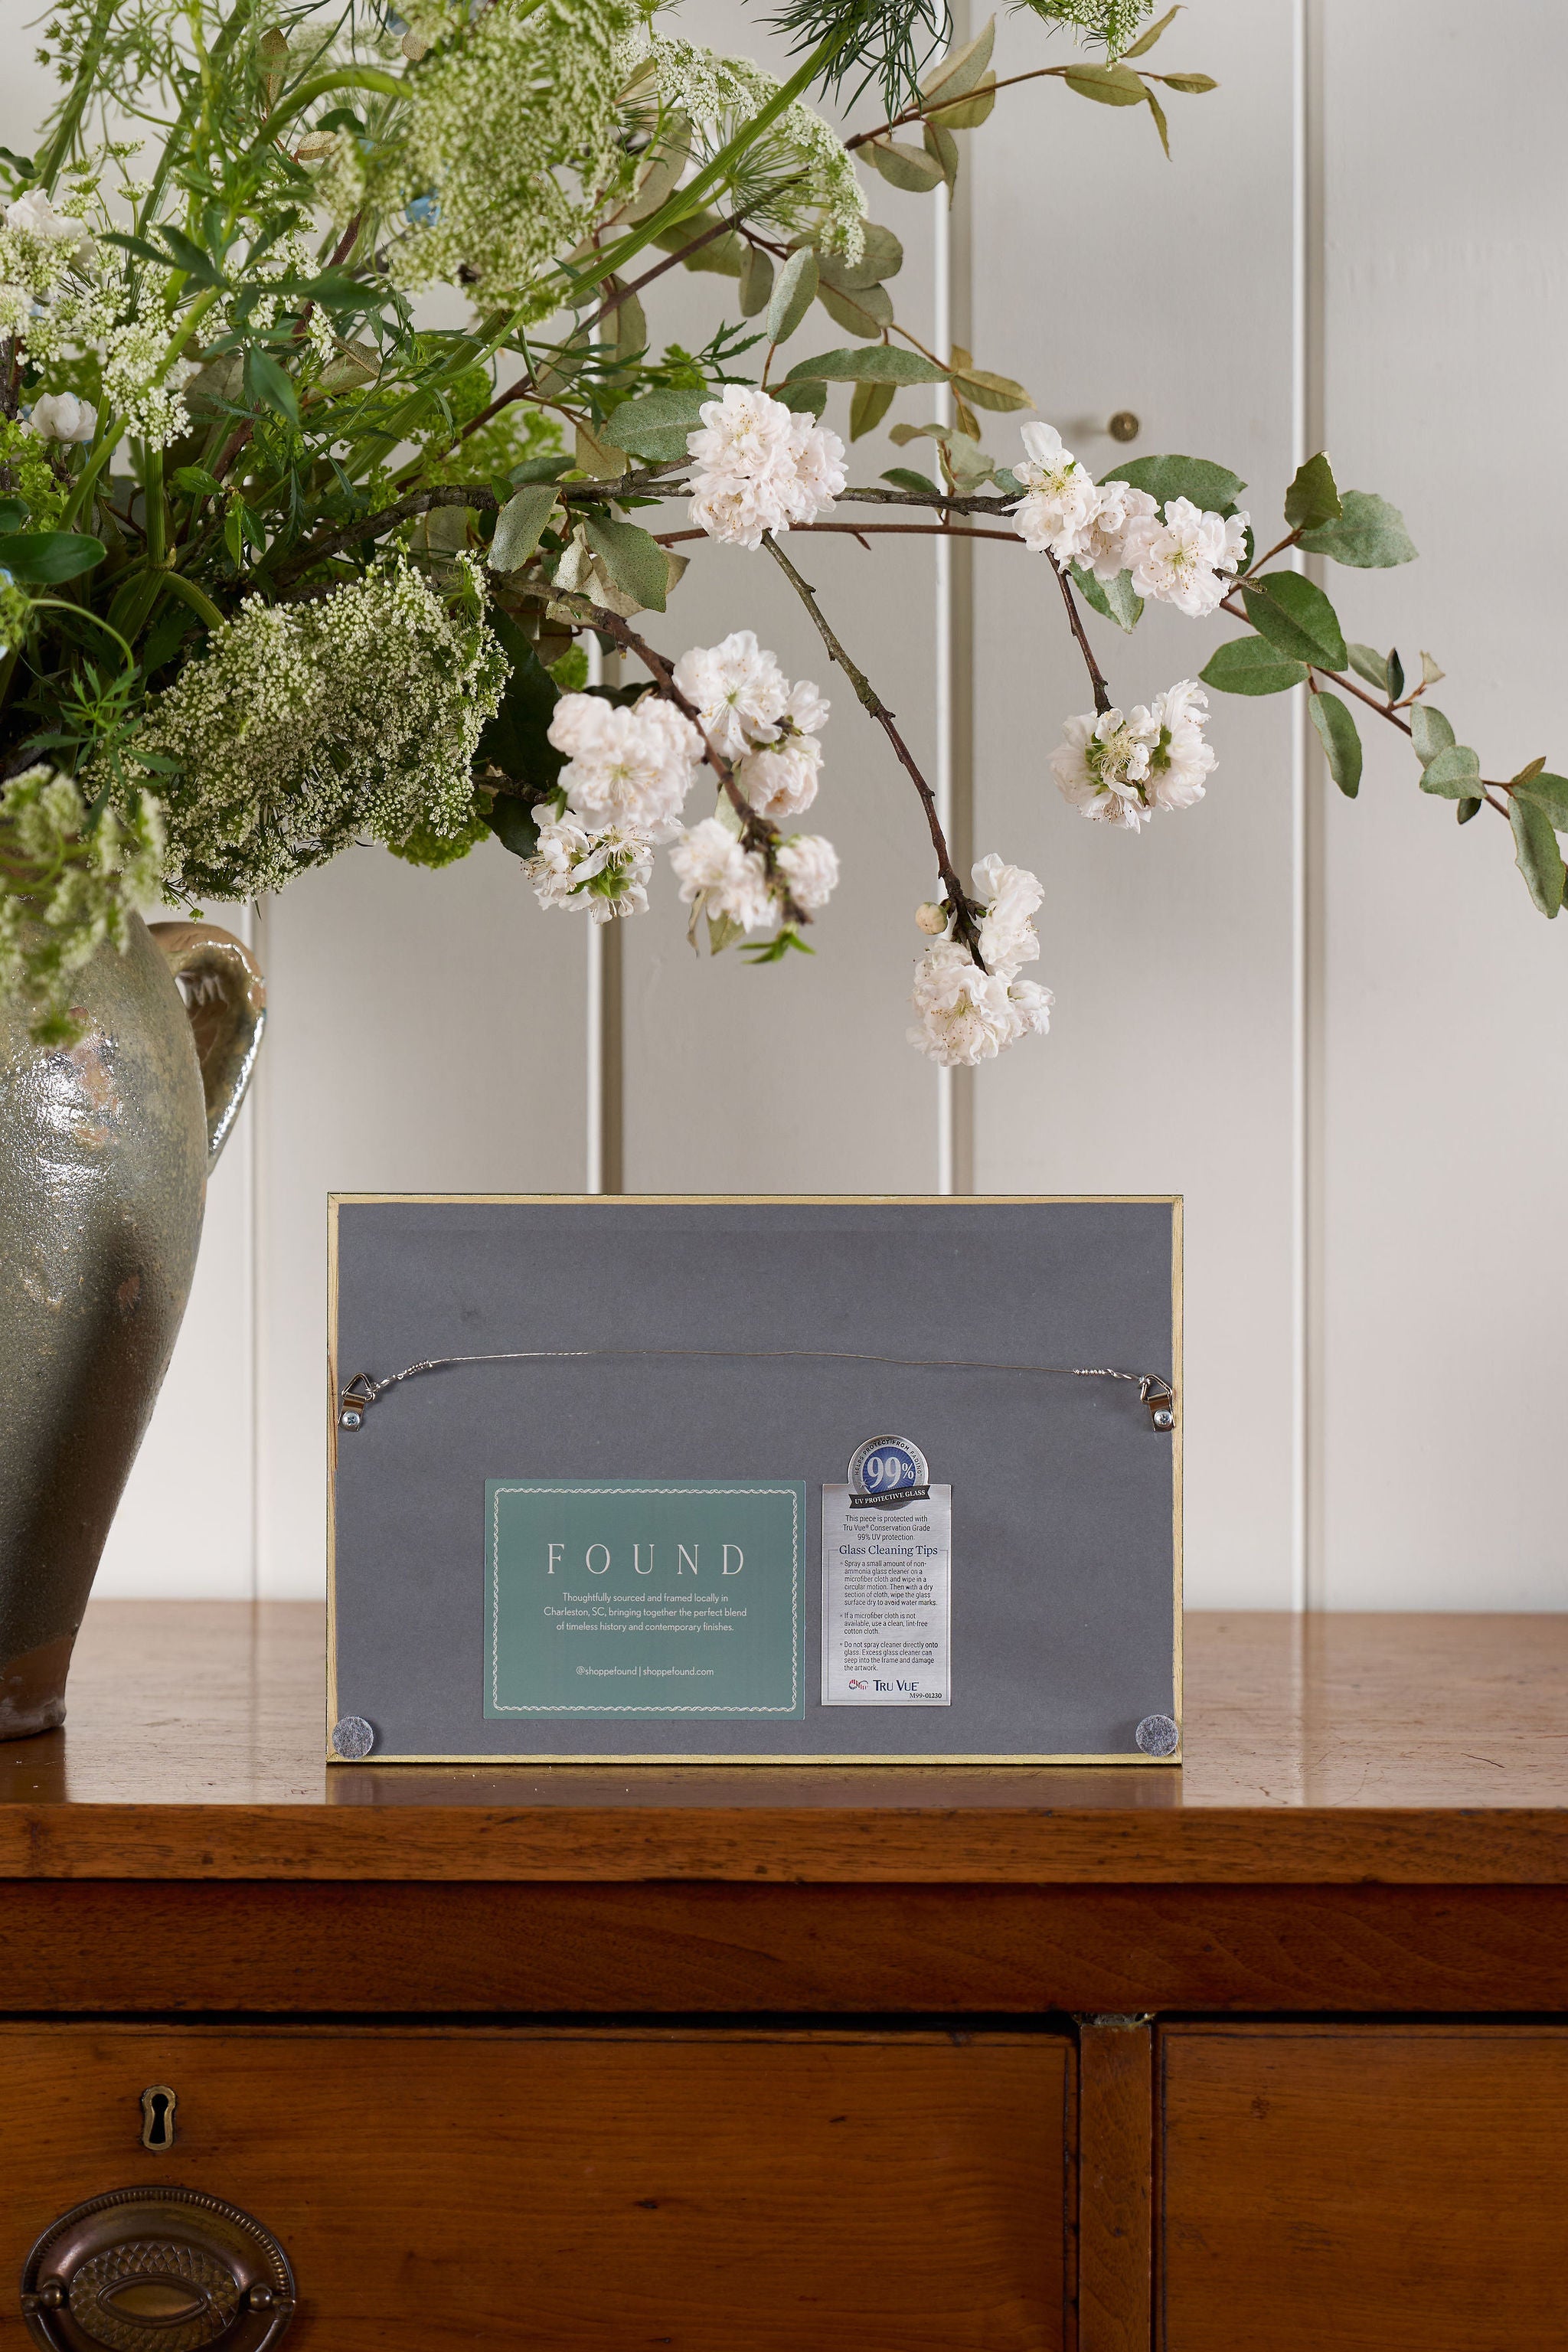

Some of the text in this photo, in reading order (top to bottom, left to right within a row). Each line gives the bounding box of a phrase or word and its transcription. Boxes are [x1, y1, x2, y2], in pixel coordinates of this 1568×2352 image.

[855, 1456, 864, 1475] HELPS
[864, 1439, 890, 1455] PROTECT
[892, 1440, 910, 1451] FROM
[867, 1457, 914, 1488] 99%
[865, 1494, 904, 1504] PROTECTIVE
[839, 1545, 937, 1557] Glass Cleaning Tips
[547, 1544, 743, 1575] FOUND
[563, 1592, 611, 1603] Thoughtfully
[613, 1593, 645, 1602] sourced
[647, 1593, 662, 1602] and
[664, 1593, 692, 1602] framed
[694, 1593, 719, 1603] locally
[544, 1607, 746, 1618] Charleston, SC, bringing together the perfect blend
[557, 1622, 565, 1630] of
[599, 1622, 626, 1632] history
[629, 1622, 643, 1631] and
[645, 1623, 701, 1632] contemporary
[703, 1622, 733, 1631] finishes.
[576, 1666, 637, 1677] @shoppefound
[643, 1667, 714, 1677] shoppefound.com
